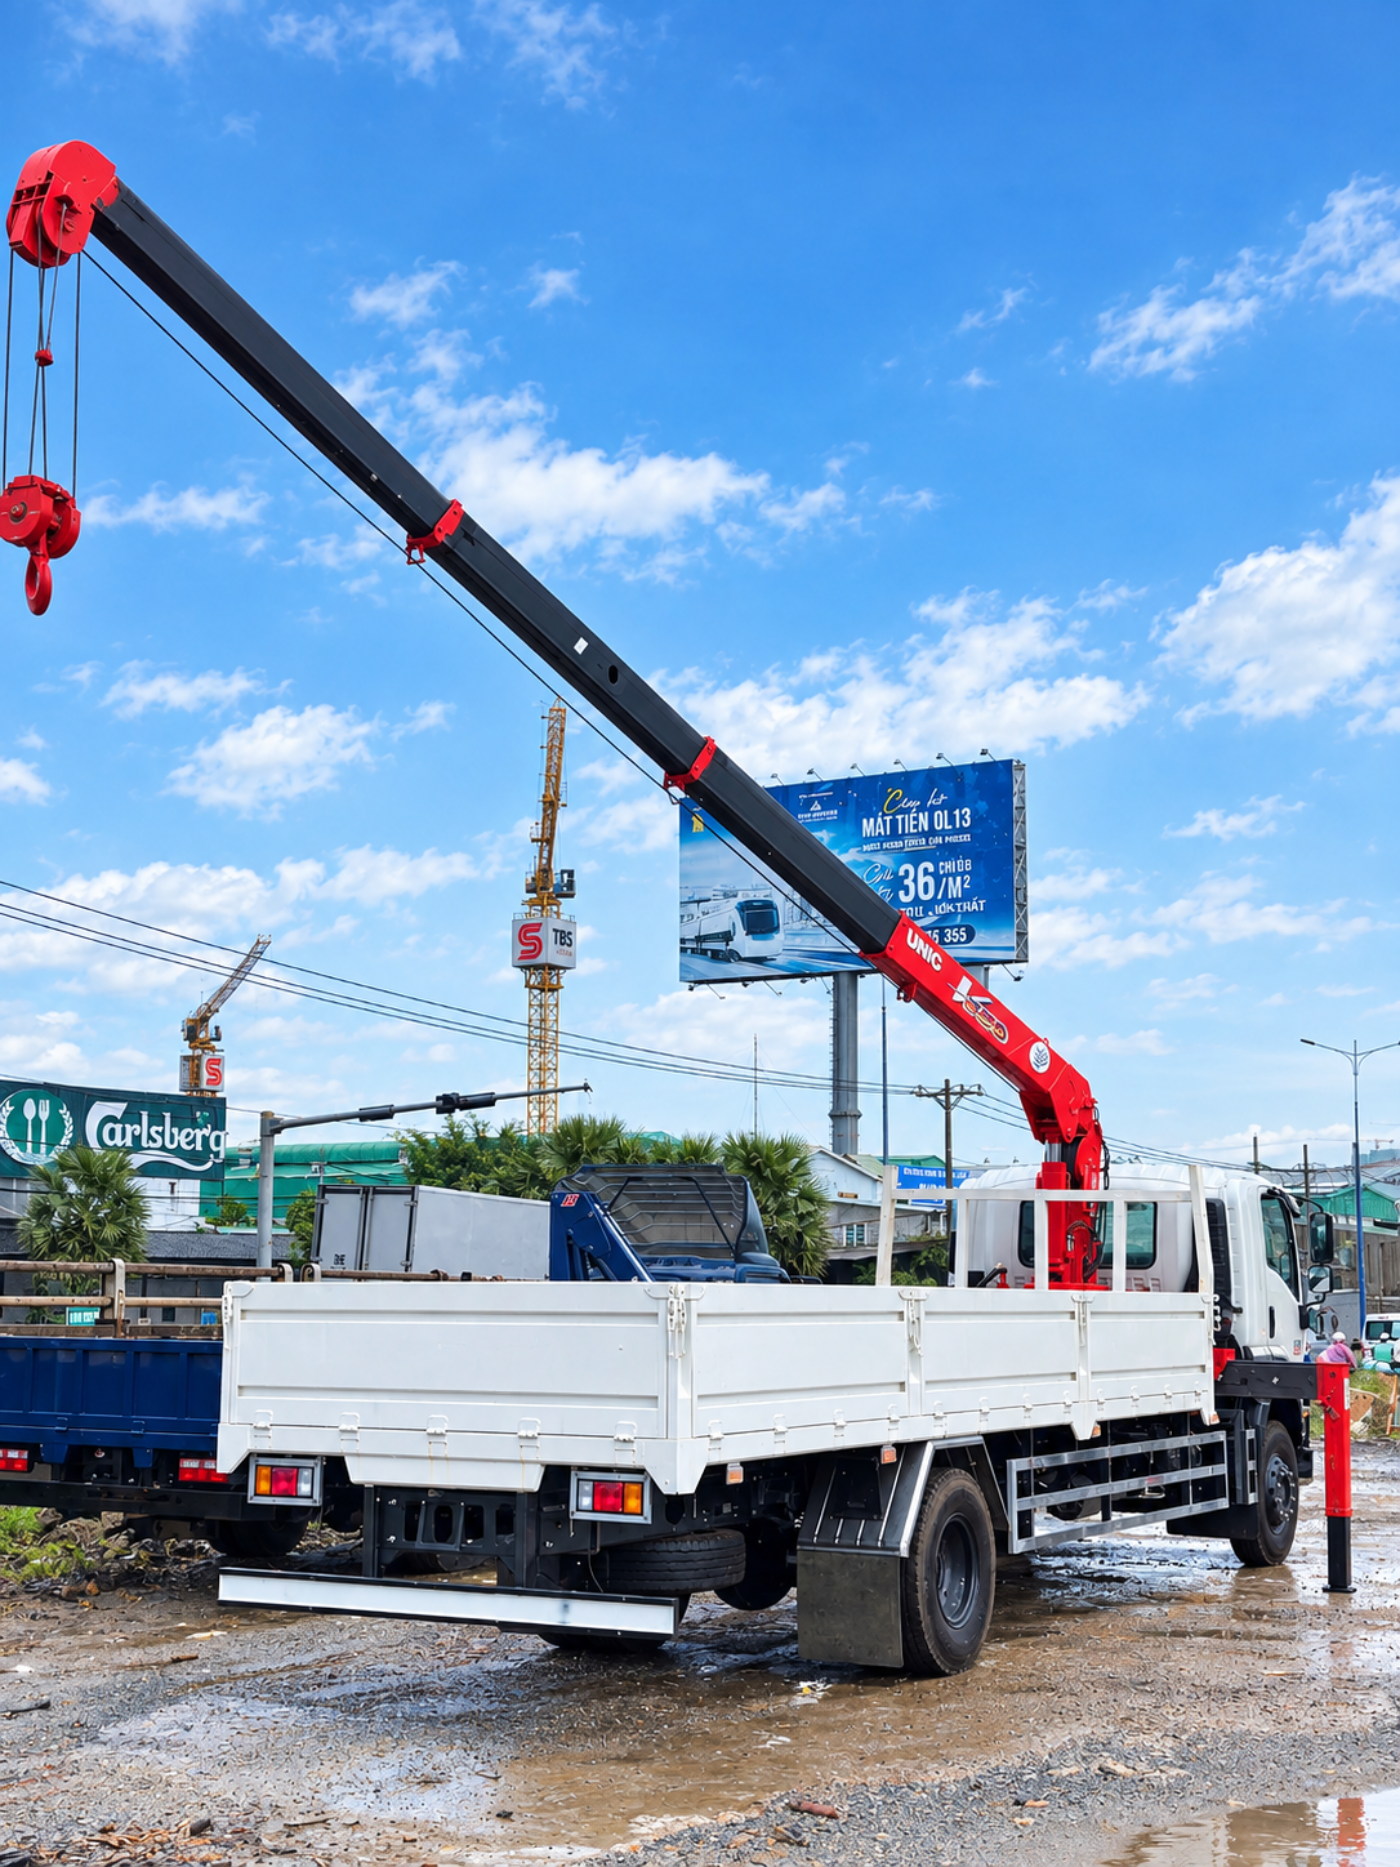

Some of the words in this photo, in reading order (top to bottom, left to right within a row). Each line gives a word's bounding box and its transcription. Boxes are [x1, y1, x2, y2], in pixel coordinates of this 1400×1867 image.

[898, 861, 935, 903] 36
[552, 927, 573, 948] TBS
[906, 928, 943, 972] UNIC
[944, 927, 967, 943] 355
[85, 1100, 230, 1163] Carlsberg
